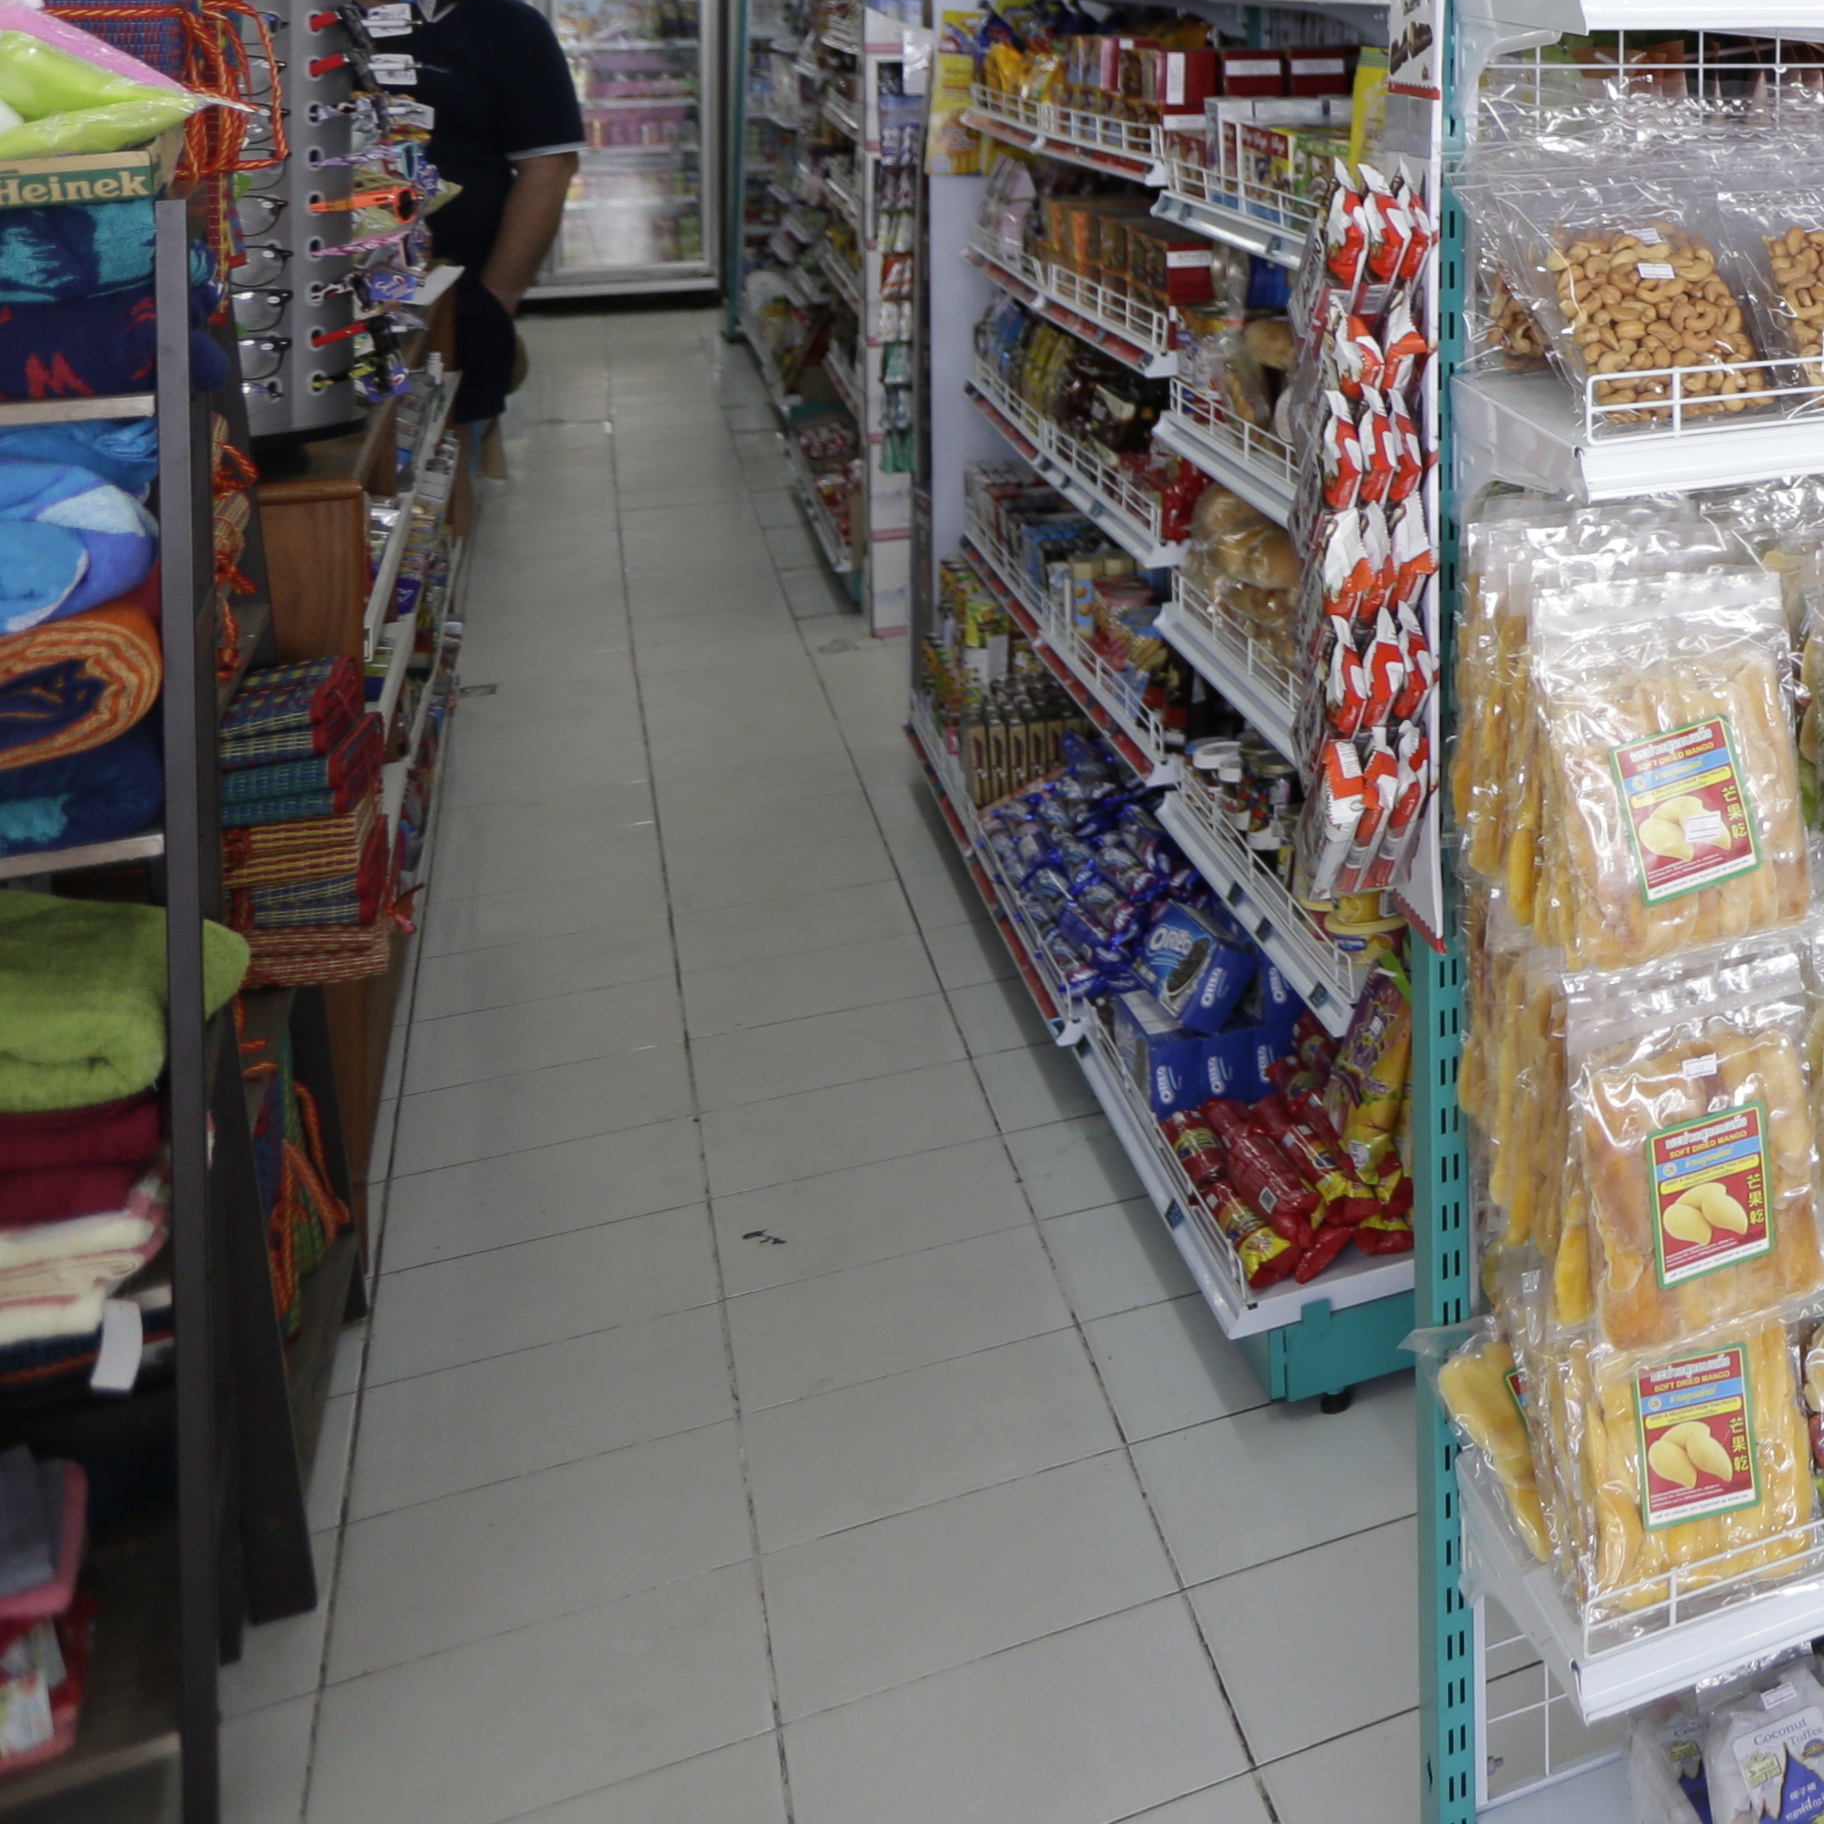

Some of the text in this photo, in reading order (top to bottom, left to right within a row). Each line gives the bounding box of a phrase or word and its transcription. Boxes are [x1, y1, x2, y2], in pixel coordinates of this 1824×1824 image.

[0, 170, 148, 206] Heinek
[1685, 741, 1715, 760] MANGO
[1719, 784, 1746, 841] 芒果乾
[1746, 1172, 1765, 1225] 芒果乾
[1729, 1418, 1749, 1475] 芒果乾
[1752, 1717, 1807, 1747] Coconut
[1788, 1726, 1824, 1746] Toffee
